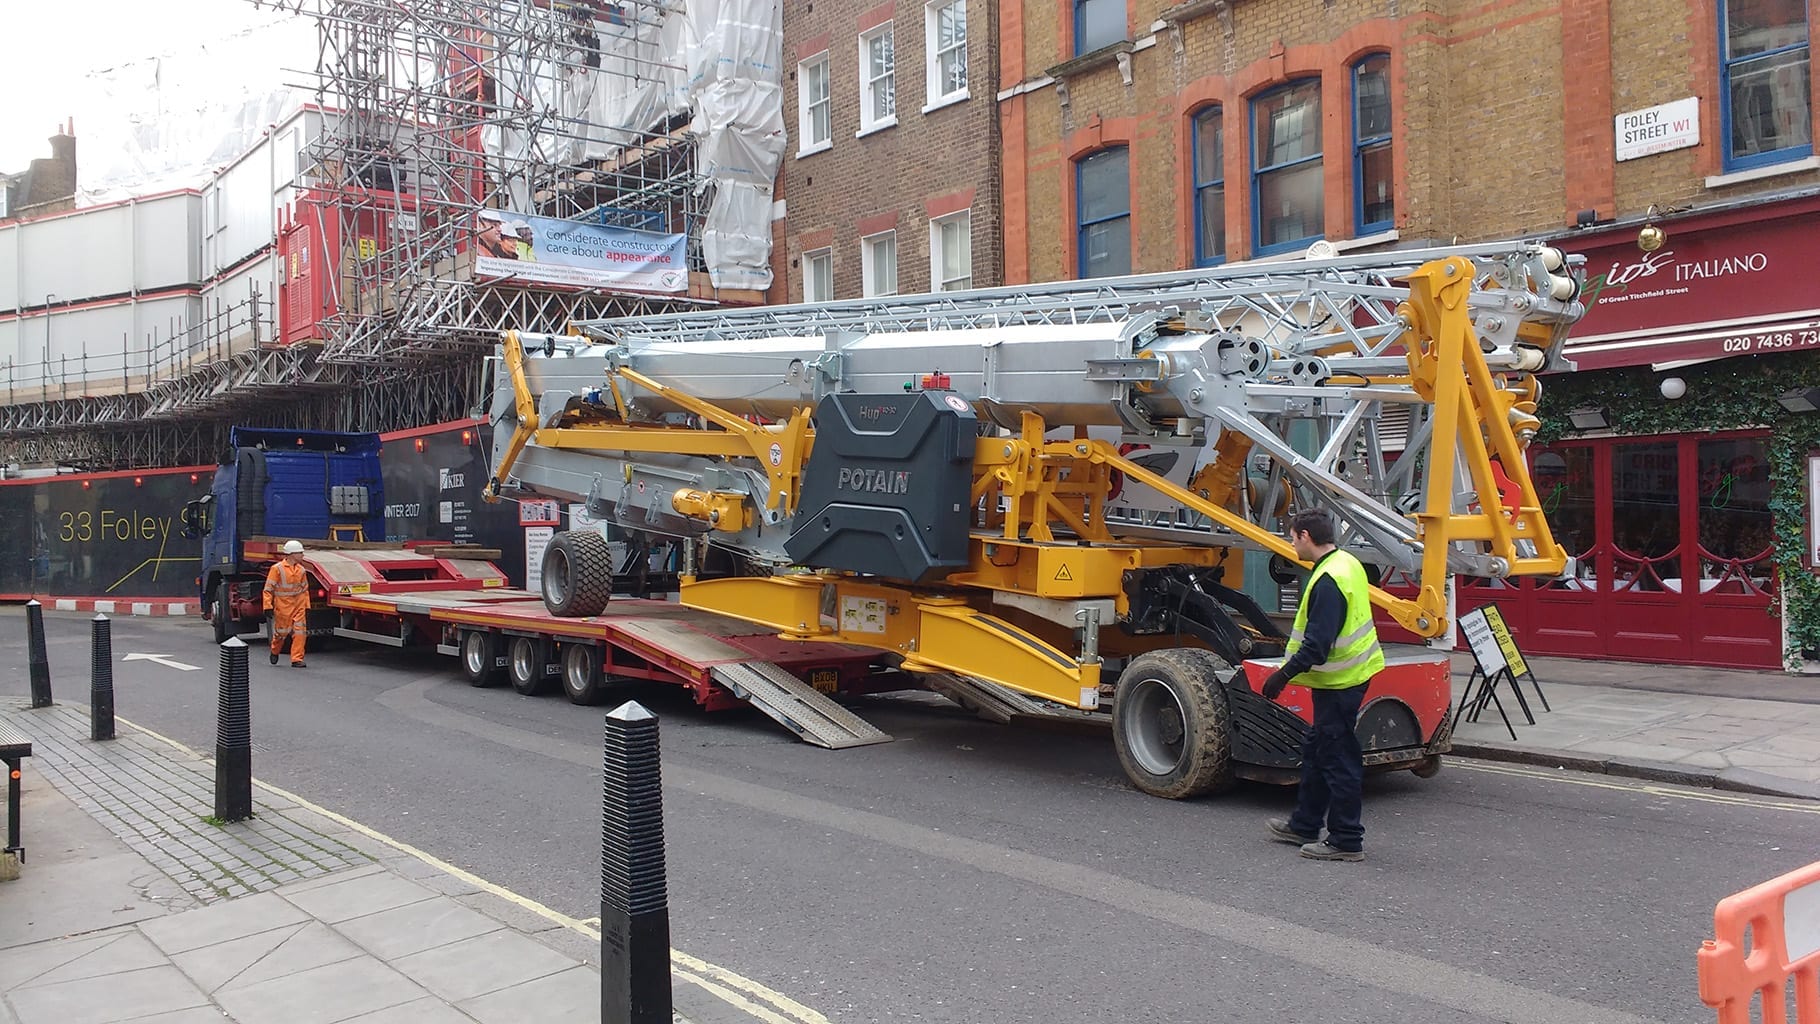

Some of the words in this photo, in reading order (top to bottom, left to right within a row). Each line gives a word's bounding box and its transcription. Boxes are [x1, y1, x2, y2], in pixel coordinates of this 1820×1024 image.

[1624, 111, 1660, 130] FOLEY
[1625, 123, 1669, 144] STREET
[1673, 119, 1690, 133] W1
[1647, 138, 1687, 152] WESTMINSTER
[546, 229, 609, 247] Considerate
[611, 238, 676, 252] constructors
[546, 243, 569, 255] care
[572, 243, 604, 259] about
[606, 250, 671, 264] appearance
[1675, 252, 1768, 282] ITALIANO
[1599, 297, 1608, 305] Of
[1608, 295, 1629, 304] Great
[1629, 290, 1664, 301] Titchfield
[1665, 286, 1689, 297] Street
[1723, 337, 1751, 353] 020
[1756, 333, 1793, 349] 7436
[1799, 331, 1820, 347] 73
[859, 405, 880, 424] Hup
[448, 473, 466, 489] KIER
[838, 467, 911, 495] POTAIN
[405, 503, 420, 517] 2017
[60, 511, 92, 542] 33
